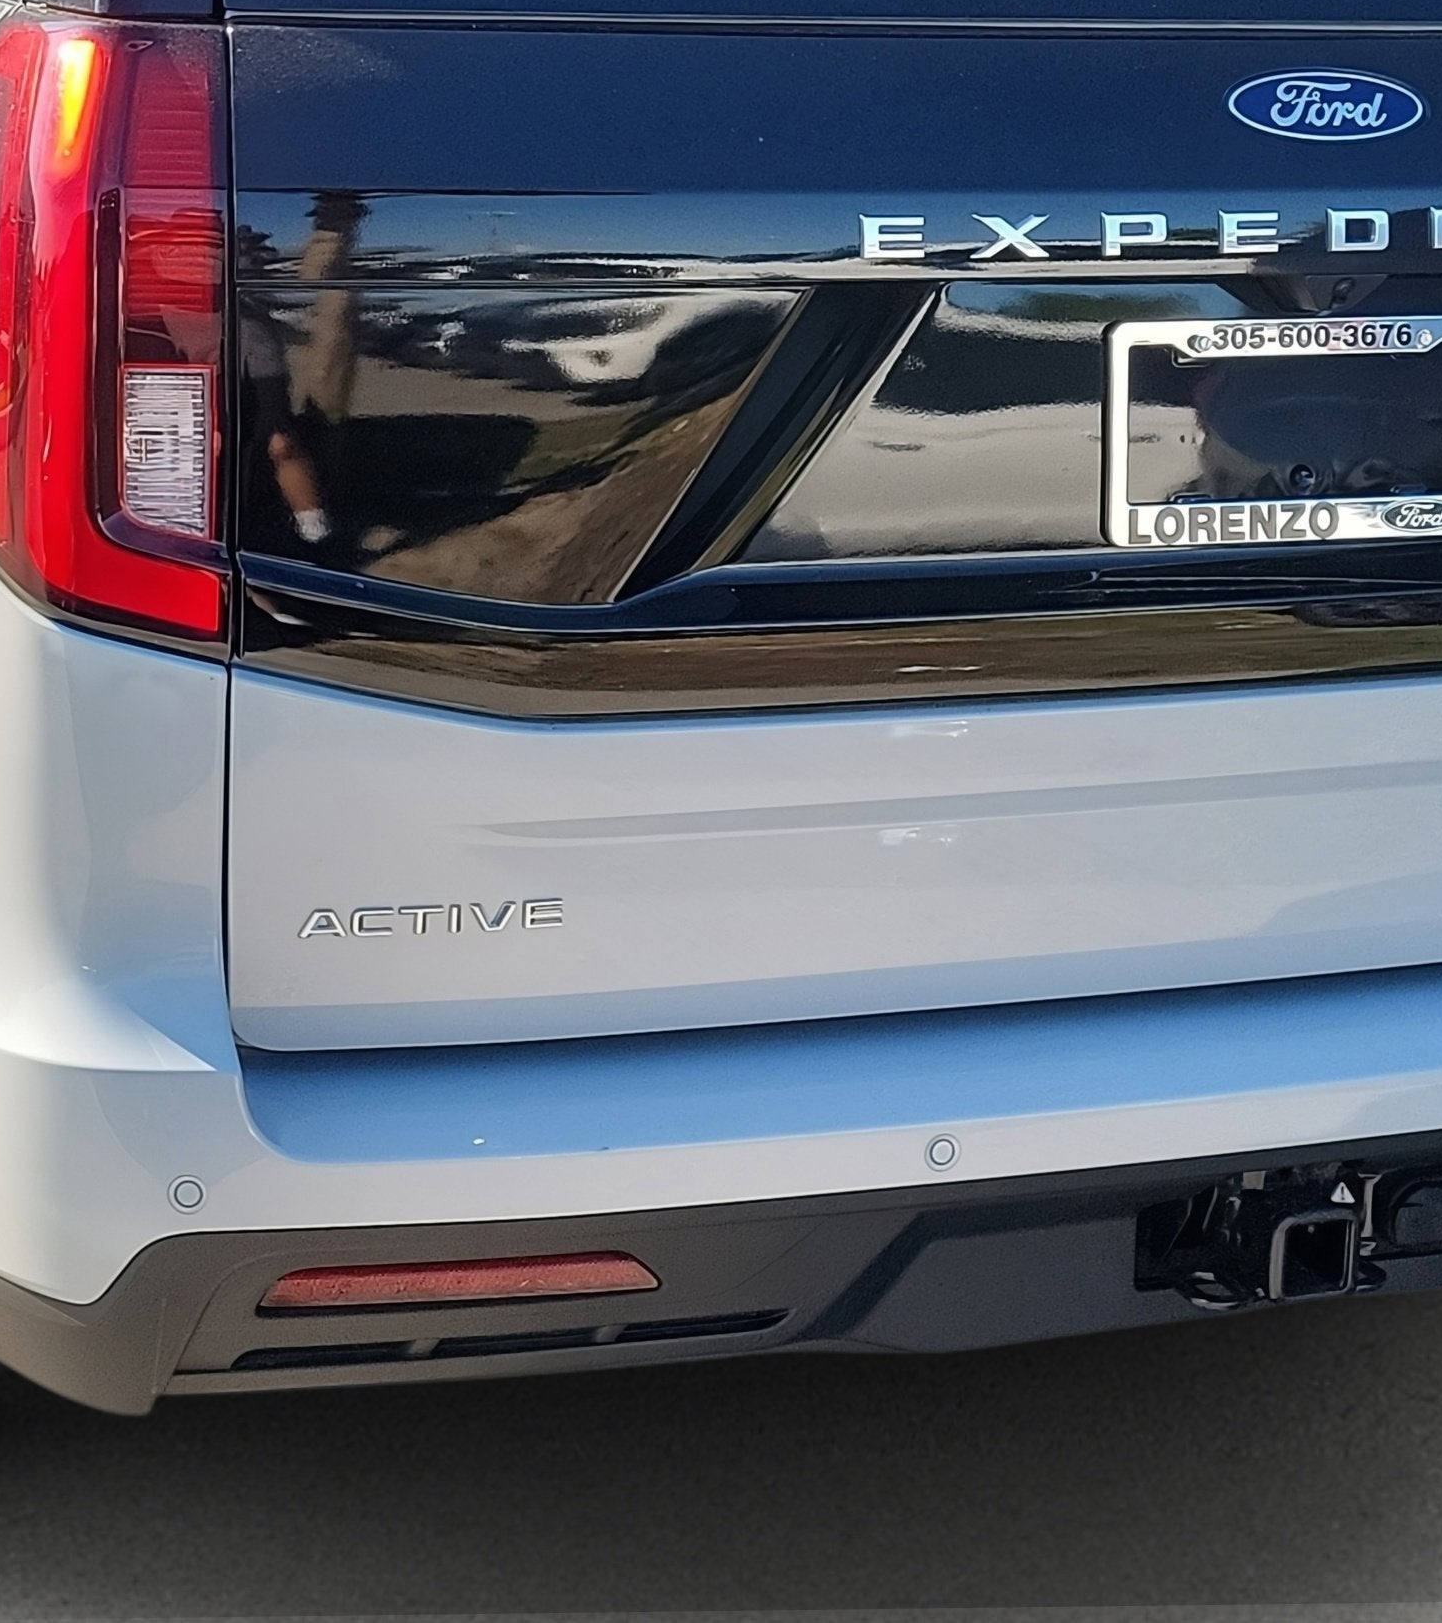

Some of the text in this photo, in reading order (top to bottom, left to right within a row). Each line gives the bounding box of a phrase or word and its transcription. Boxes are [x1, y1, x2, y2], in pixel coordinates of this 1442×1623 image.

[1270, 80, 1387, 127] Ford
[1212, 323, 1413, 350] 305-600-3676
[1128, 501, 1339, 545] LORENZO
[297, 898, 563, 939] ACTIVE
